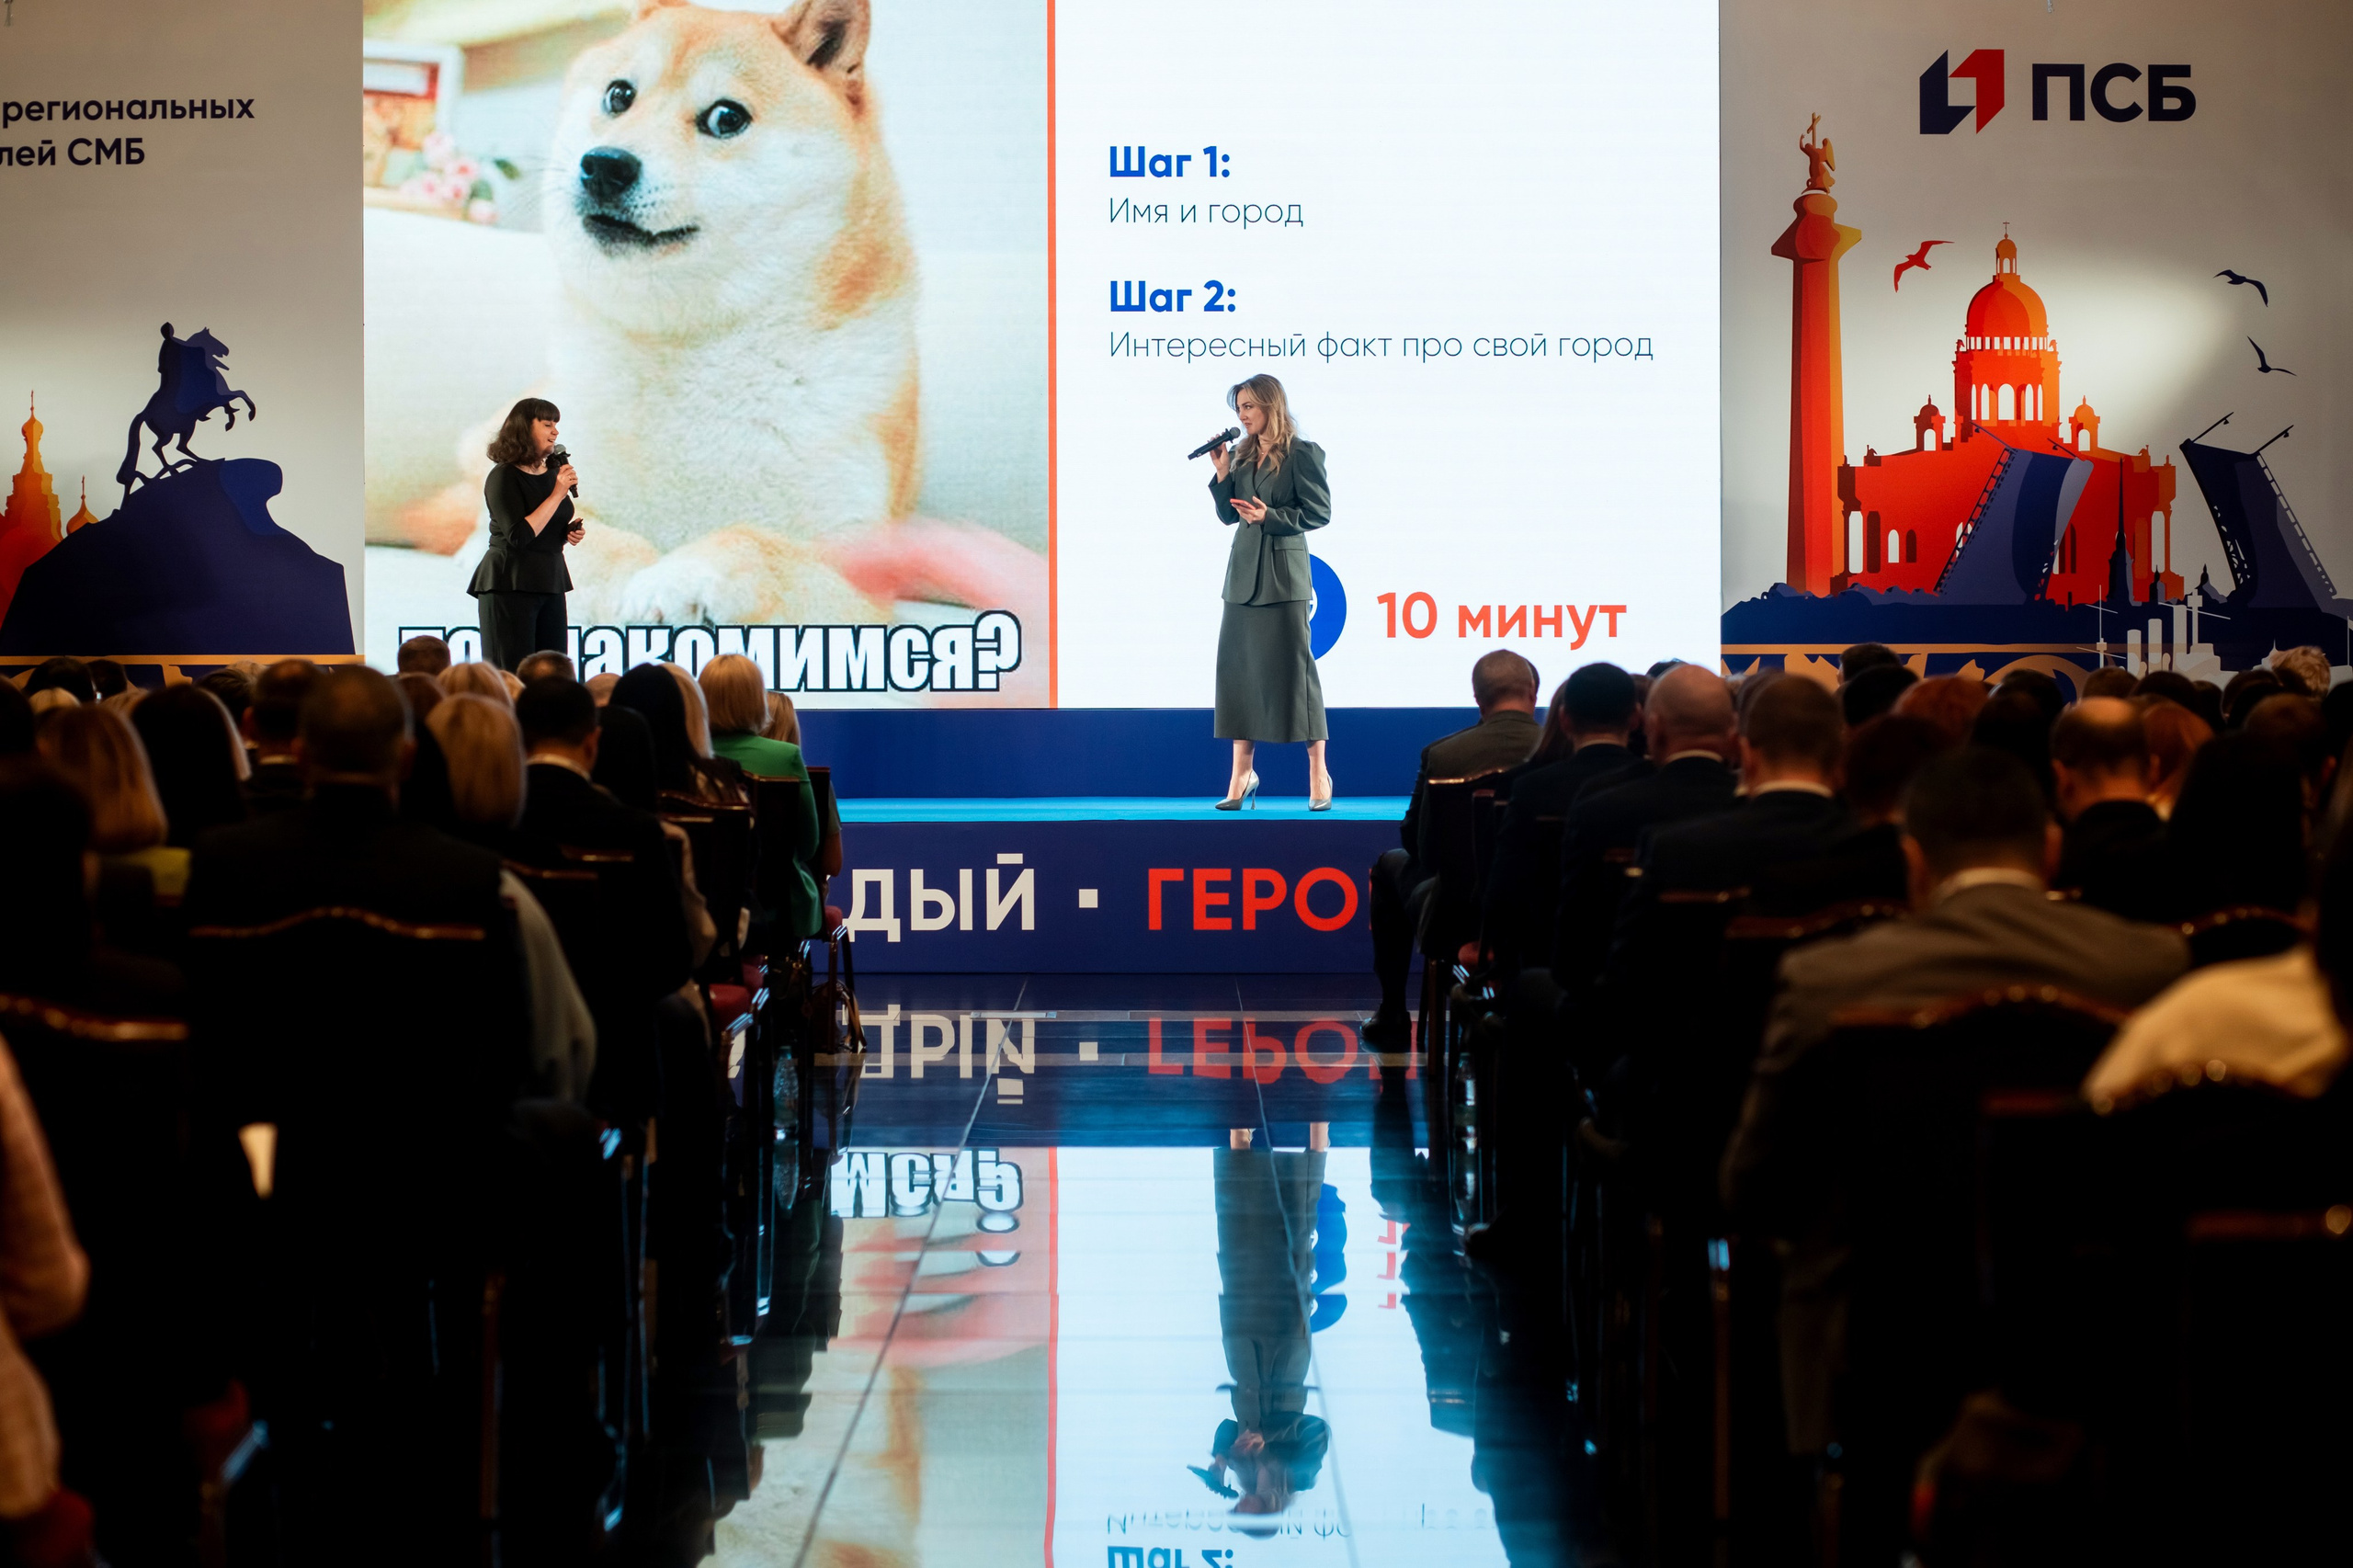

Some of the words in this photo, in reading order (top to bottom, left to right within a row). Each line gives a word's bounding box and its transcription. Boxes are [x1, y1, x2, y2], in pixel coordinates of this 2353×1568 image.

[2032, 62, 2197, 123] ПСБ
[2, 98, 256, 129] региональных
[0, 139, 56, 166] лей
[67, 137, 145, 166] СМБ
[1109, 145, 1192, 178] Шаг
[1202, 145, 1231, 178] 1:
[1109, 197, 1168, 223] Имя
[1180, 203, 1197, 223] и
[1209, 203, 1304, 230] город
[1109, 279, 1192, 312] Шаг
[1203, 278, 1237, 313] 2:
[1109, 330, 1306, 364] Интересный
[1317, 330, 1393, 364] факт
[1403, 336, 1463, 364] про
[1472, 333, 1547, 358] свой
[1559, 336, 1654, 364] город
[1377, 591, 1438, 640] 10
[1458, 604, 1628, 651] минут
[841, 853, 1035, 943] ДЫЙ
[1148, 867, 1373, 932] ГЕРО
